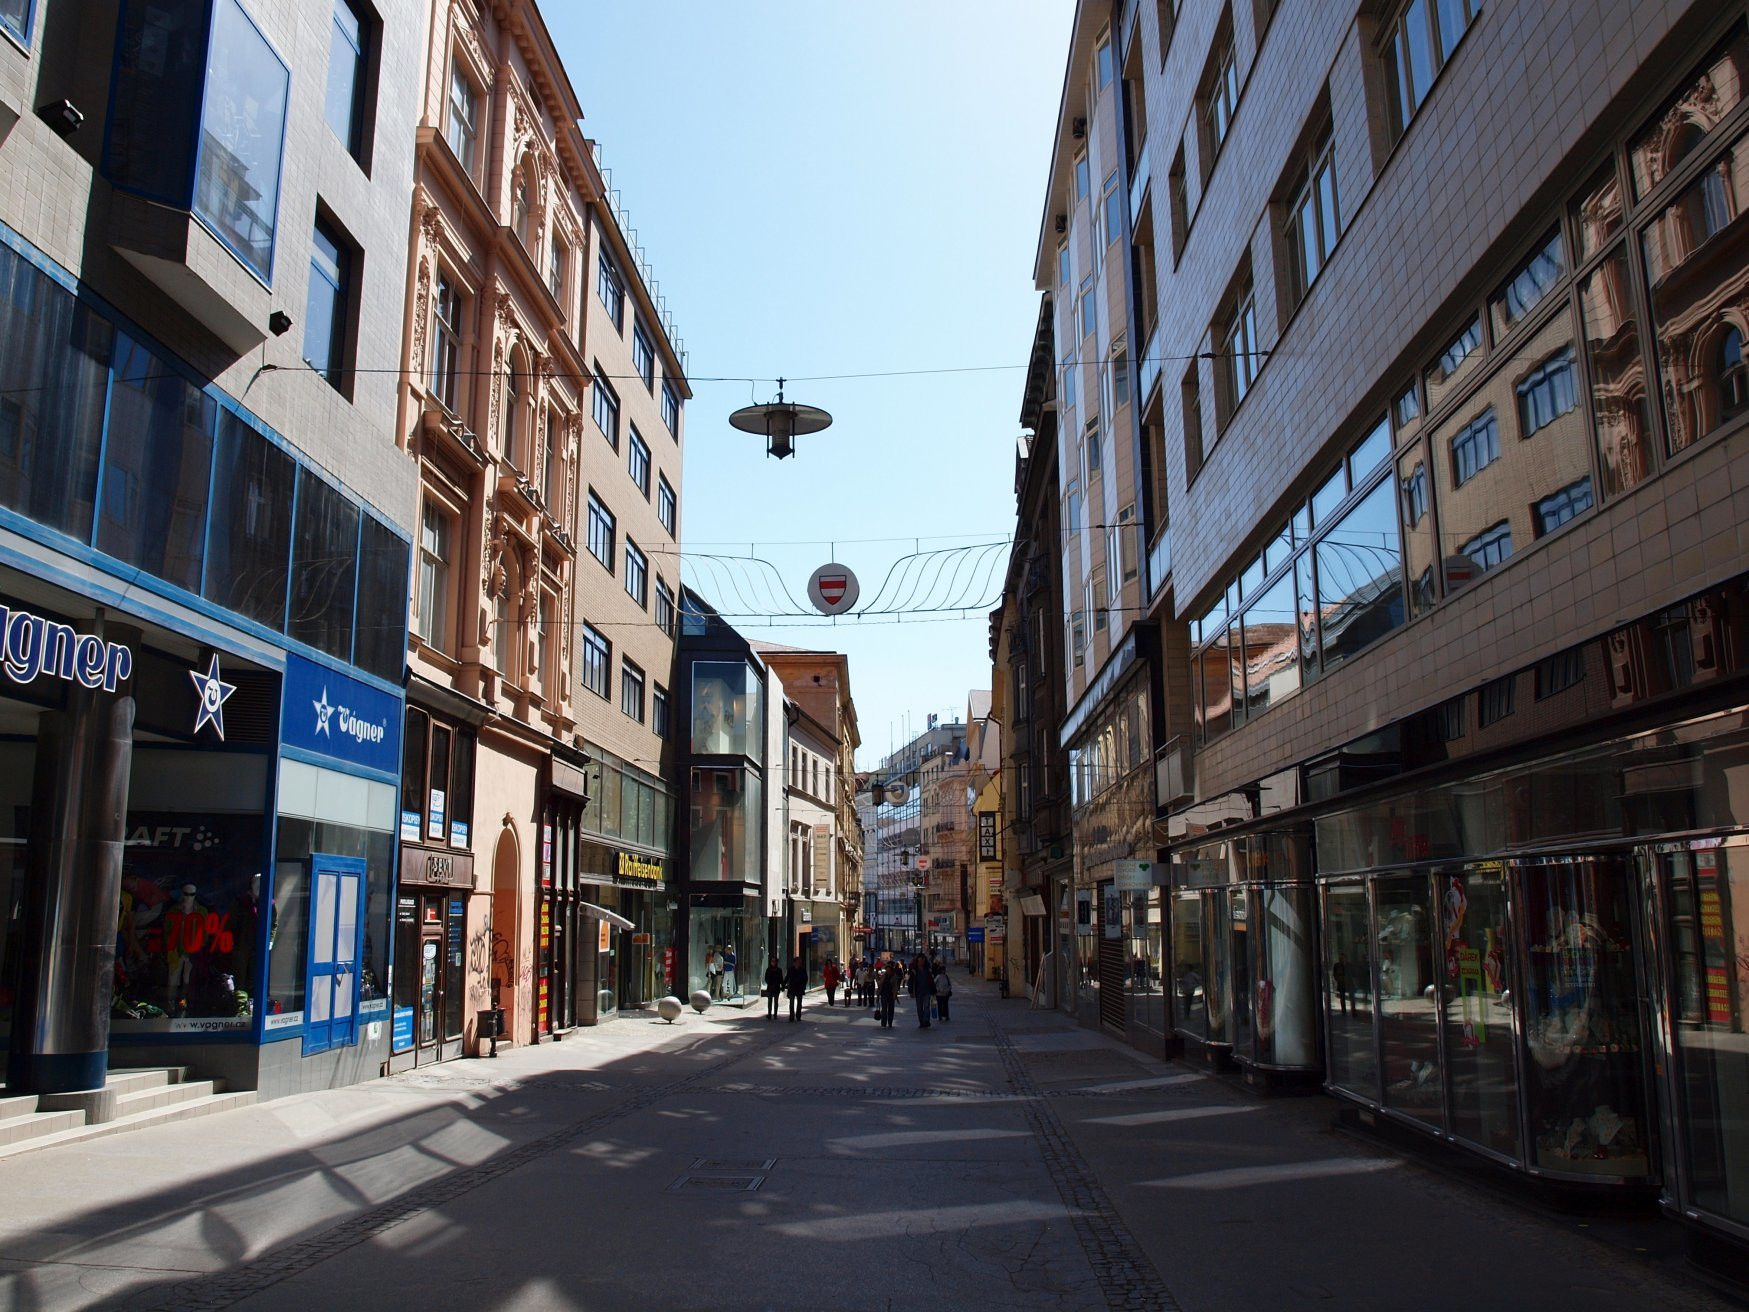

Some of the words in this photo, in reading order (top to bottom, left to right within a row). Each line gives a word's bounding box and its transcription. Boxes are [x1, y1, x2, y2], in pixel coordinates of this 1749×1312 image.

[124, 825, 192, 848] AFT
[983, 816, 992, 856] TAXI
[624, 853, 663, 881] Raiffeisenbank
